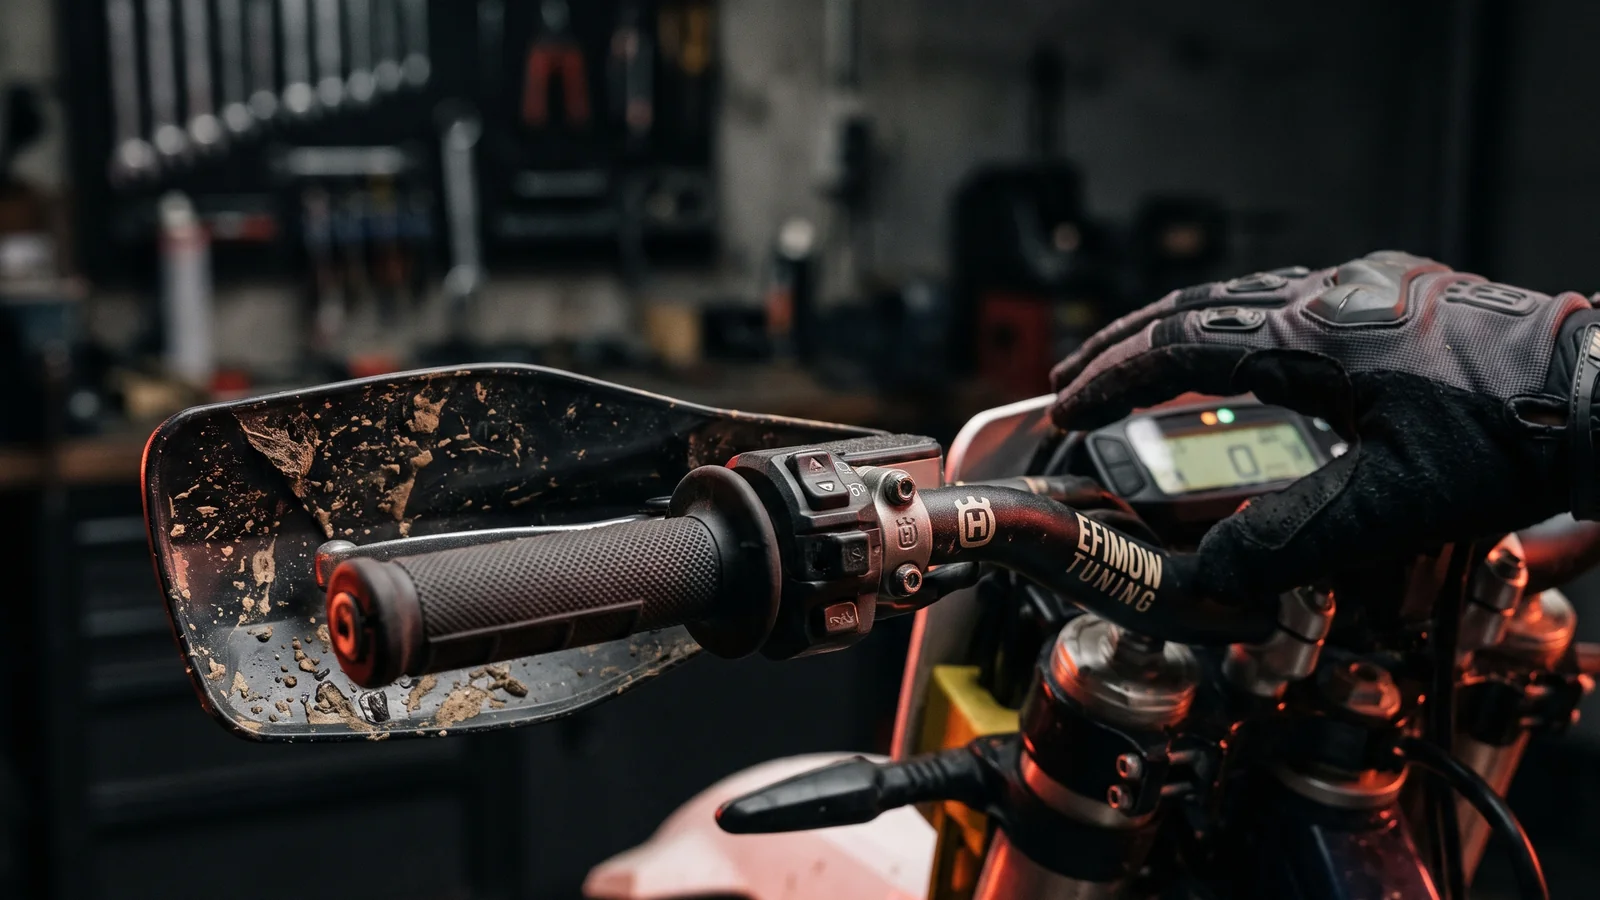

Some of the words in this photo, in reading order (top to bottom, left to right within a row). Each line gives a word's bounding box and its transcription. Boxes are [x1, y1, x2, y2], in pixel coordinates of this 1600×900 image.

[1228, 444, 1261, 478] 0
[1075, 512, 1162, 590] EFIMOW
[1066, 552, 1155, 612] TUNING
